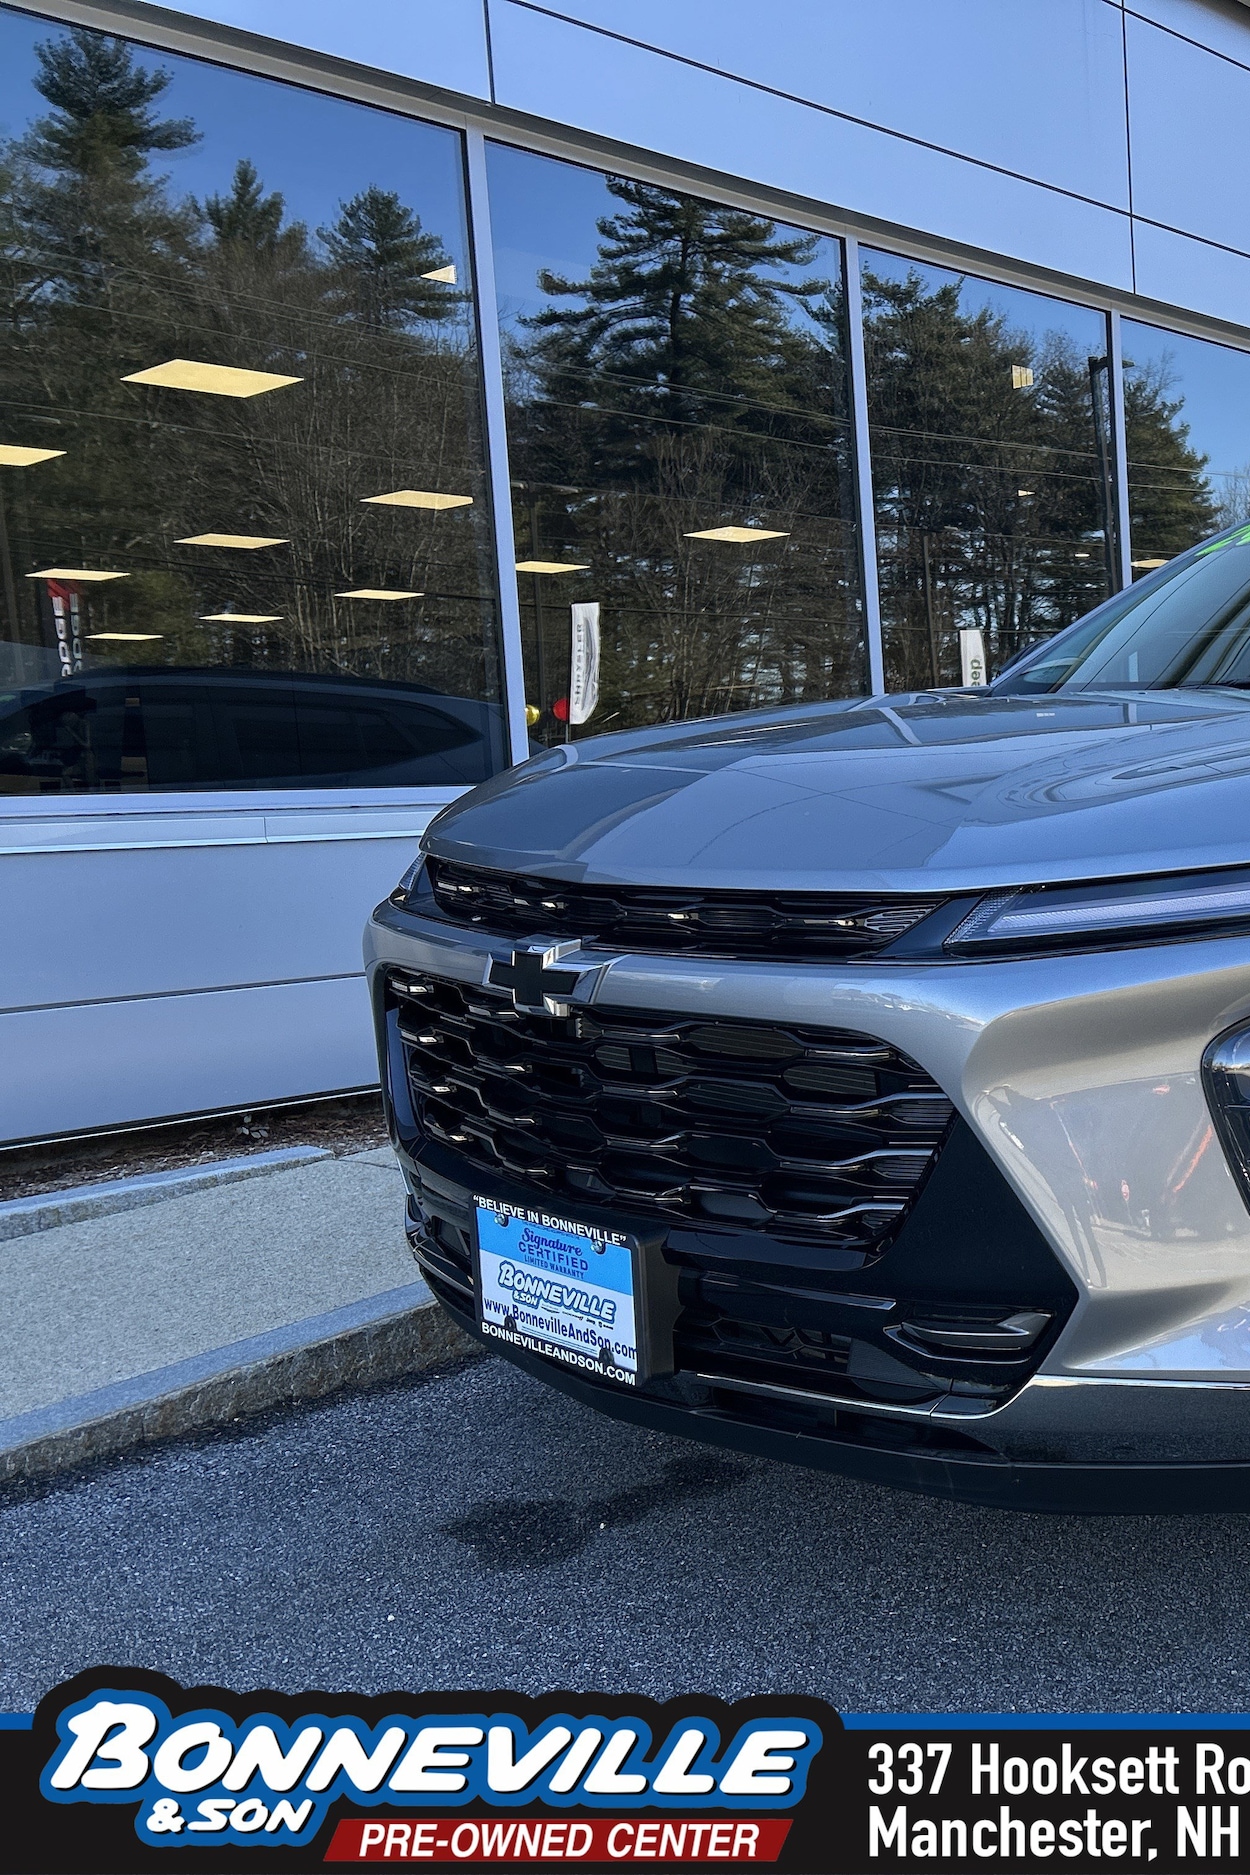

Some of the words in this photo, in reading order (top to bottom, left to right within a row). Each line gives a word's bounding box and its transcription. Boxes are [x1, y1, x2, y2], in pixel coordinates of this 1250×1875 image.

[527, 1210, 539, 1224] IN
[518, 1242, 589, 1271] CERTIFIED
[521, 1227, 583, 1257] Signature
[524, 1255, 548, 1270] LIMITED
[550, 1263, 585, 1280] WARRANTY
[498, 1261, 617, 1324] BONNEVILLE
[484, 1298, 638, 1360] www.BonnevilleAndSon.com
[481, 1322, 636, 1386] BONNEVILLEANDSON.COM
